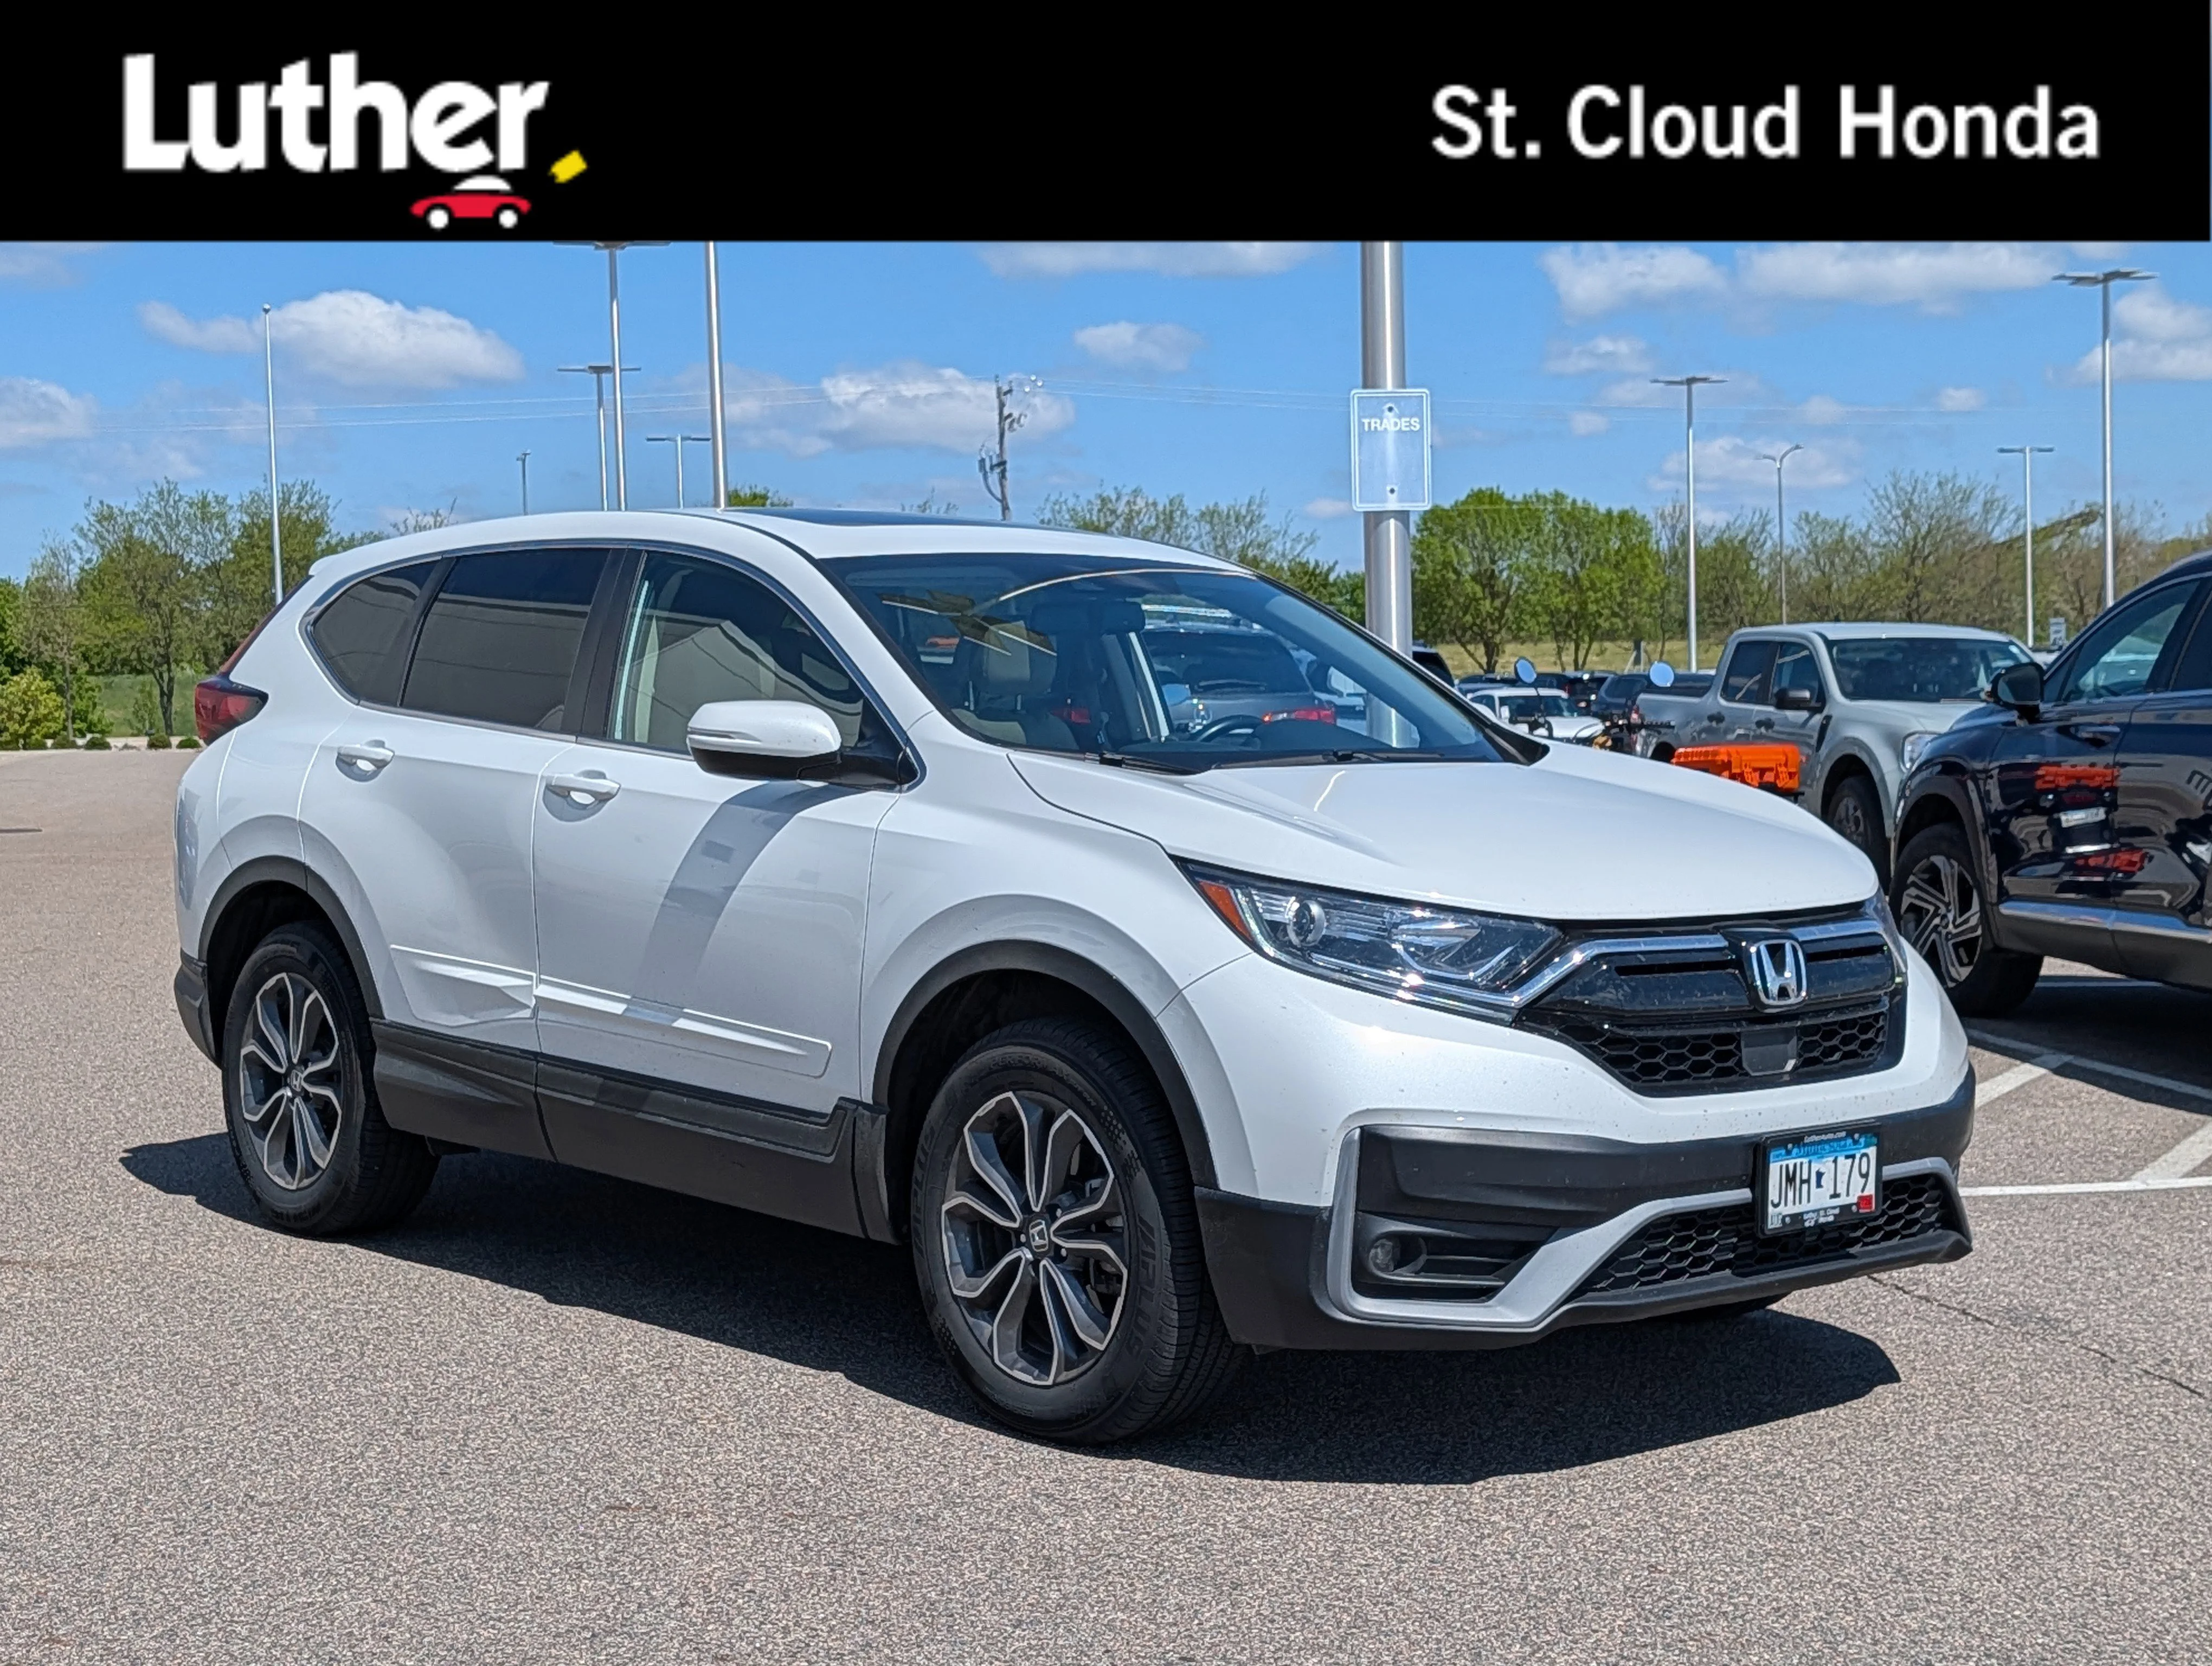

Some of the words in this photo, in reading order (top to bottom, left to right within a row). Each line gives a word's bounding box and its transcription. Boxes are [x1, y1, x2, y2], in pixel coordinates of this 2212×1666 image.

[1361, 418, 1421, 432] TRADES
[1770, 1159, 1812, 1209] JMH
[1829, 1152, 1870, 1200] 179
